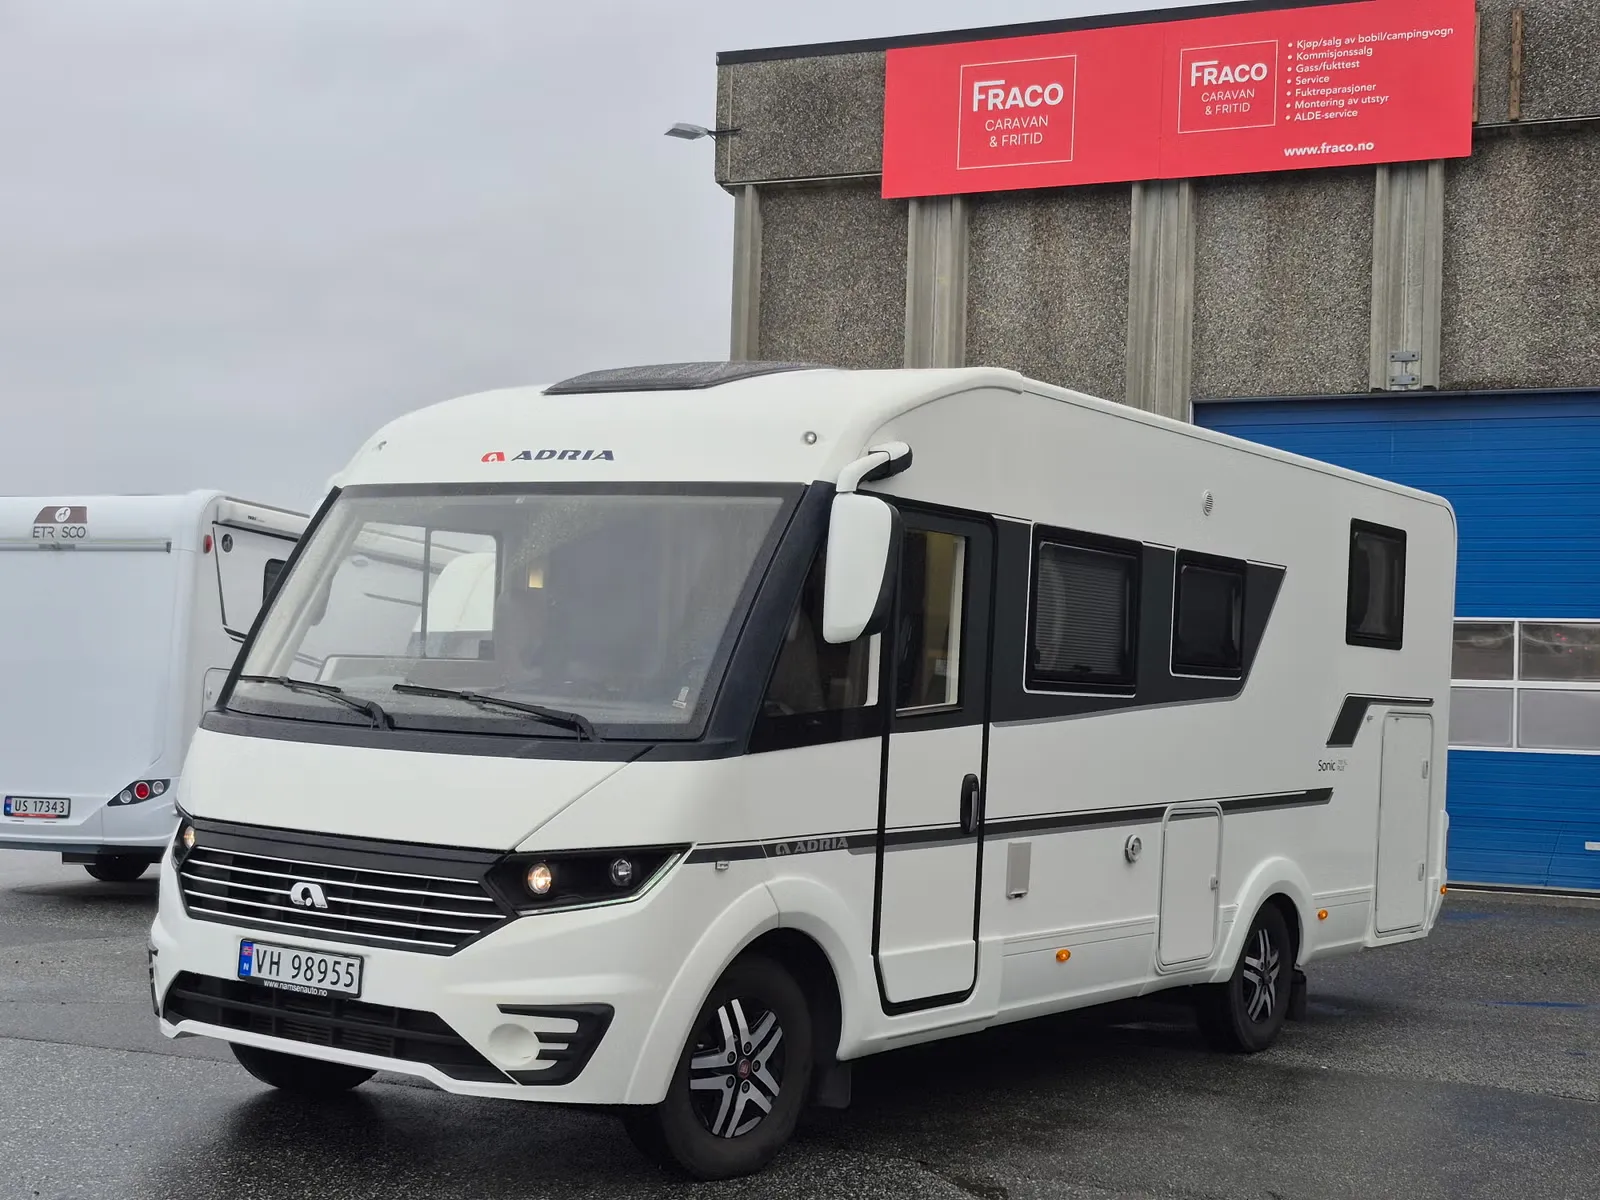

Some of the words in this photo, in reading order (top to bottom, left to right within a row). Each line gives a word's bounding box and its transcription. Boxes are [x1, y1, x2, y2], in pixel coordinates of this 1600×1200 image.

[1296, 36, 1342, 50] Kjøp/salg
[1344, 37, 1356, 45] av
[1358, 27, 1454, 44] bobil/campingvogn
[1296, 46, 1373, 61] Kommisjonssalg
[1190, 60, 1268, 87] FRACO
[1295, 60, 1360, 73] Gass/fukttest
[1295, 74, 1330, 86] Service
[972, 79, 1064, 112] FRACO
[1201, 88, 1255, 103] CARAVAN
[1295, 83, 1377, 97] Fuktreparasjoner
[1204, 105, 1212, 116] &
[1215, 102, 1251, 115] FRITID
[1294, 97, 1345, 110] Montering
[1347, 98, 1359, 106] av
[1361, 94, 1390, 105] utstyr
[985, 115, 1049, 131] CARAVAN
[1294, 109, 1358, 122] ALDE-service
[989, 135, 998, 148] &
[1001, 132, 1043, 147] FRITID
[1284, 141, 1375, 157] www.fraco.no
[511, 449, 615, 461] ADRIA
[1318, 759, 1336, 771] Sonic
[14, 799, 28, 812] US
[33, 800, 65, 814] 17343
[793, 837, 849, 853] ADRIA
[242, 962, 249, 971] N
[255, 948, 282, 977] VH
[291, 954, 355, 988] 98955
[263, 979, 328, 997] www.namsenauto.no
